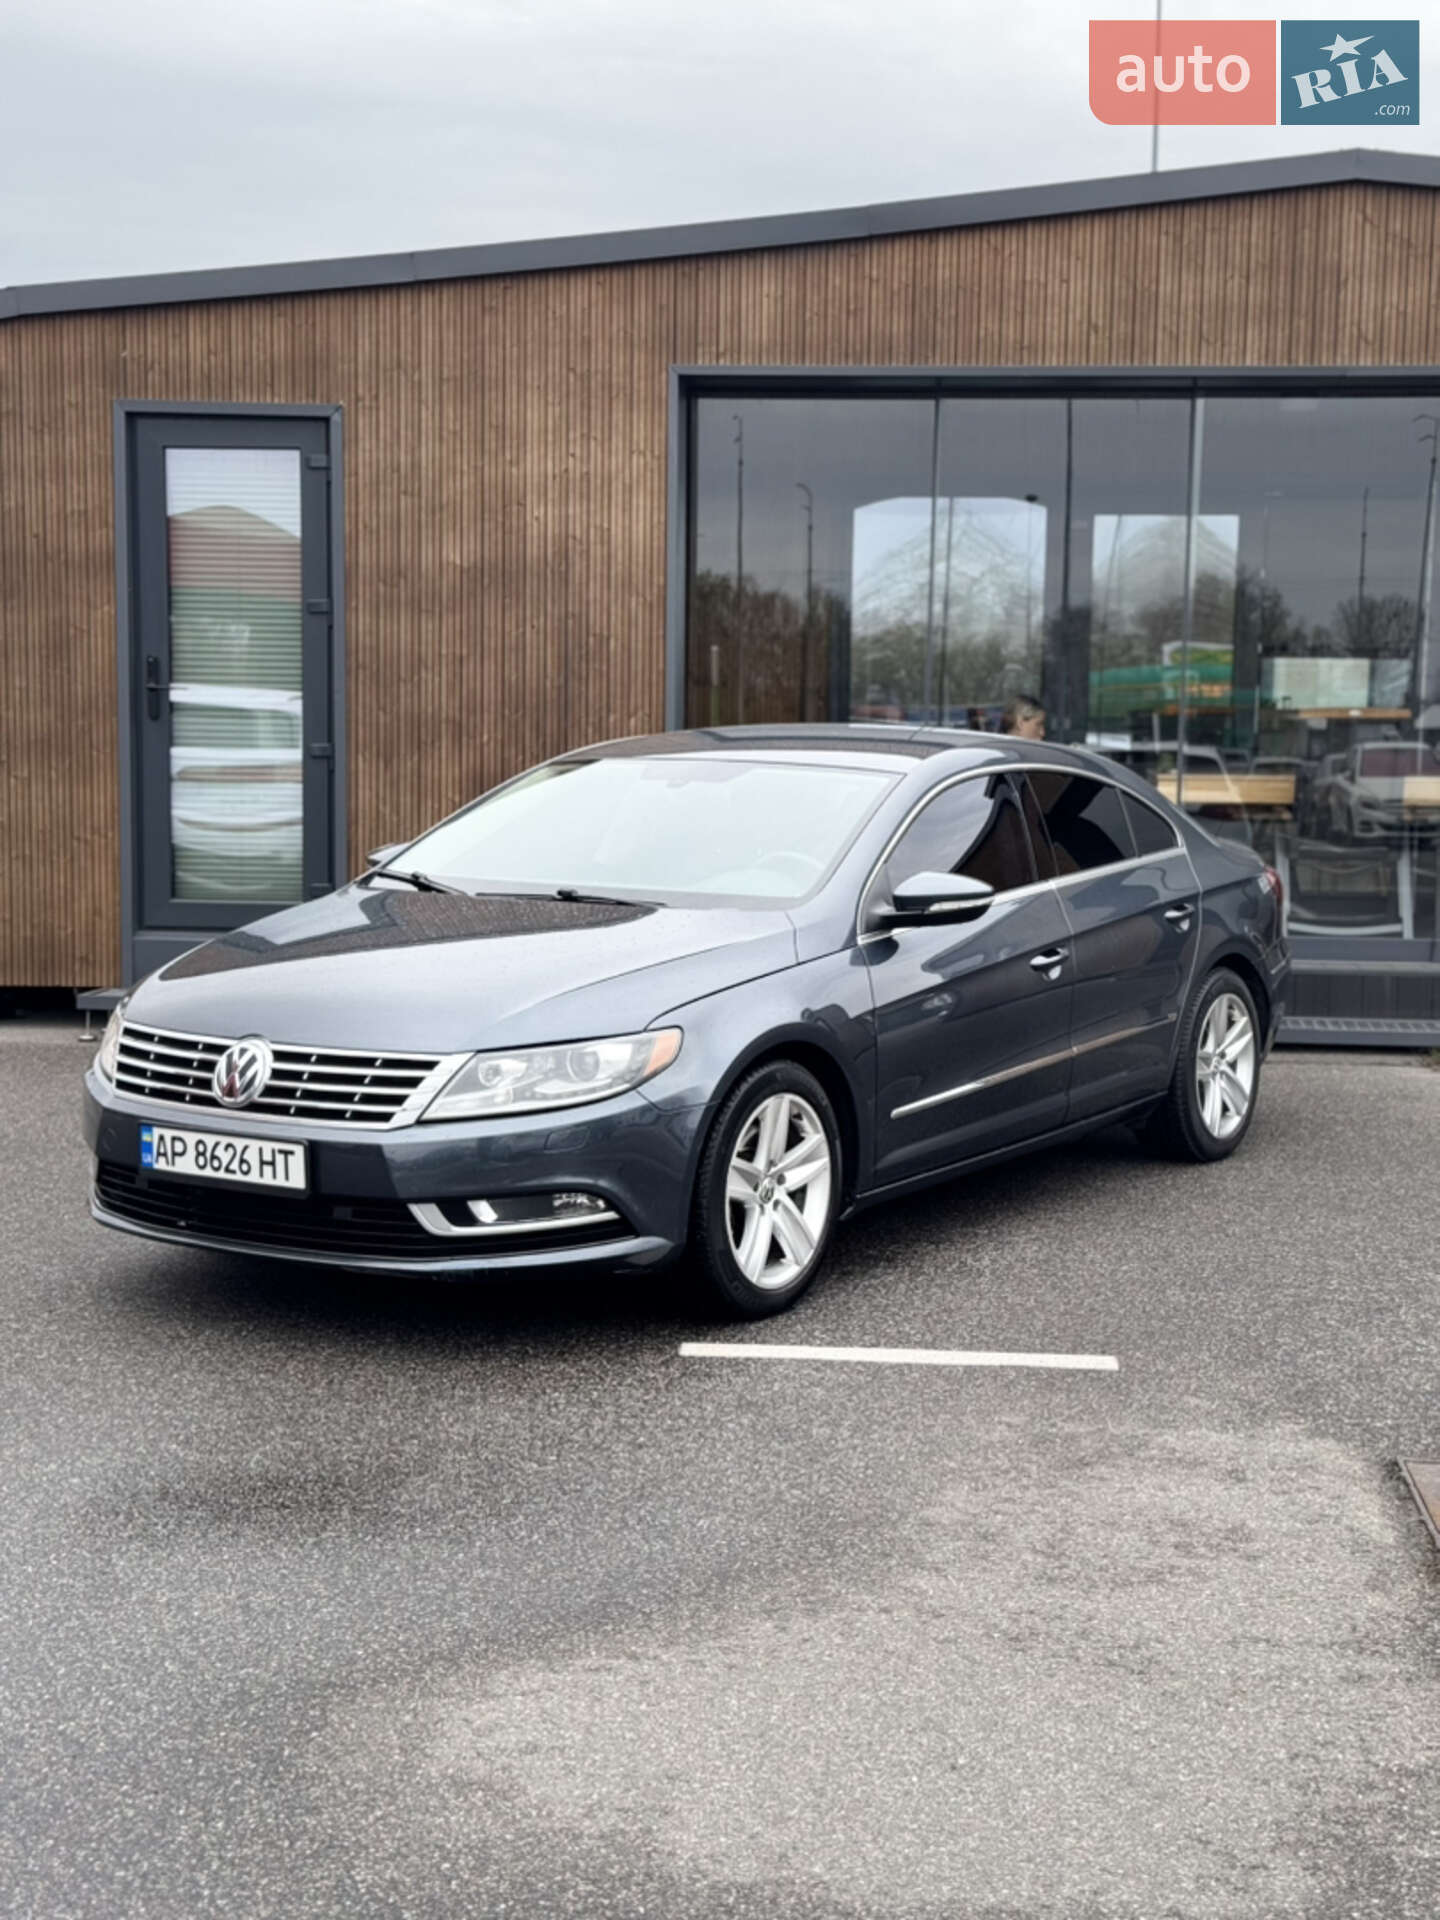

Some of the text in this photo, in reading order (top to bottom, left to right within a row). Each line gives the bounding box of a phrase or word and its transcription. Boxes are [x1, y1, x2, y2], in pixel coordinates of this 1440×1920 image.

[155, 1133, 296, 1182] AP 8626 HT
